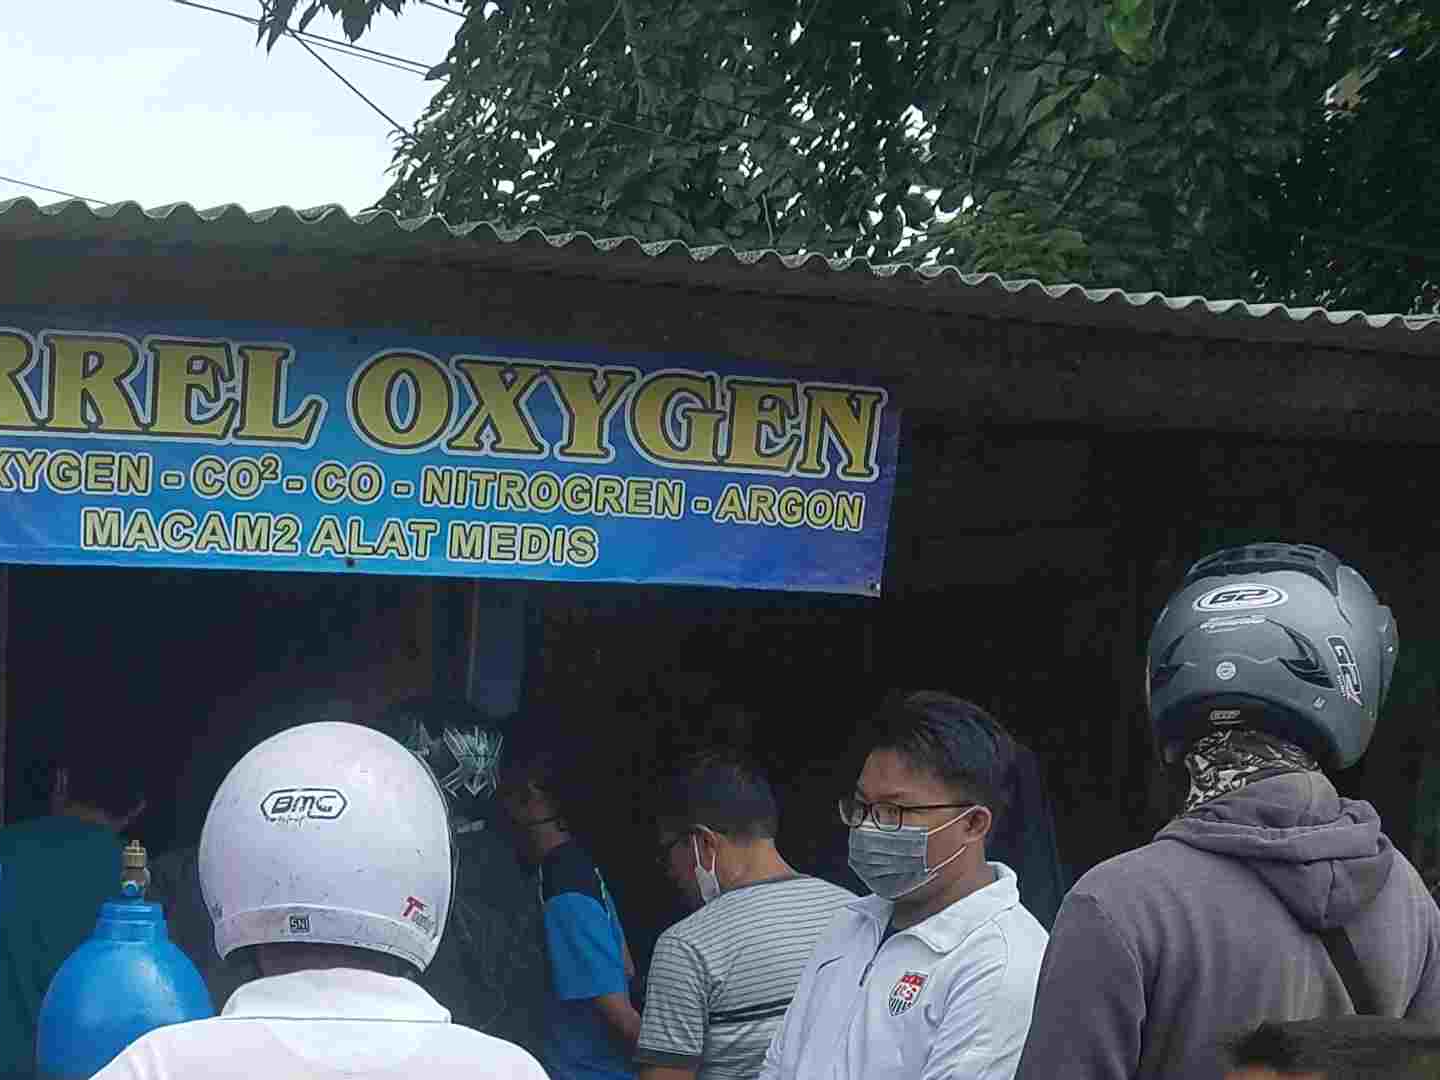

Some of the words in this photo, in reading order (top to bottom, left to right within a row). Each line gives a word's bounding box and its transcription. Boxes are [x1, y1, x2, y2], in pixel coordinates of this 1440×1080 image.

[347, 349, 888, 481] OXYGEN
[313, 460, 384, 504] CO
[422, 466, 685, 521] NITROGREN
[713, 482, 865, 532] ARGON
[80, 506, 301, 556] MACAM2
[307, 514, 439, 560] ALAT
[447, 520, 599, 567] MEDIS
